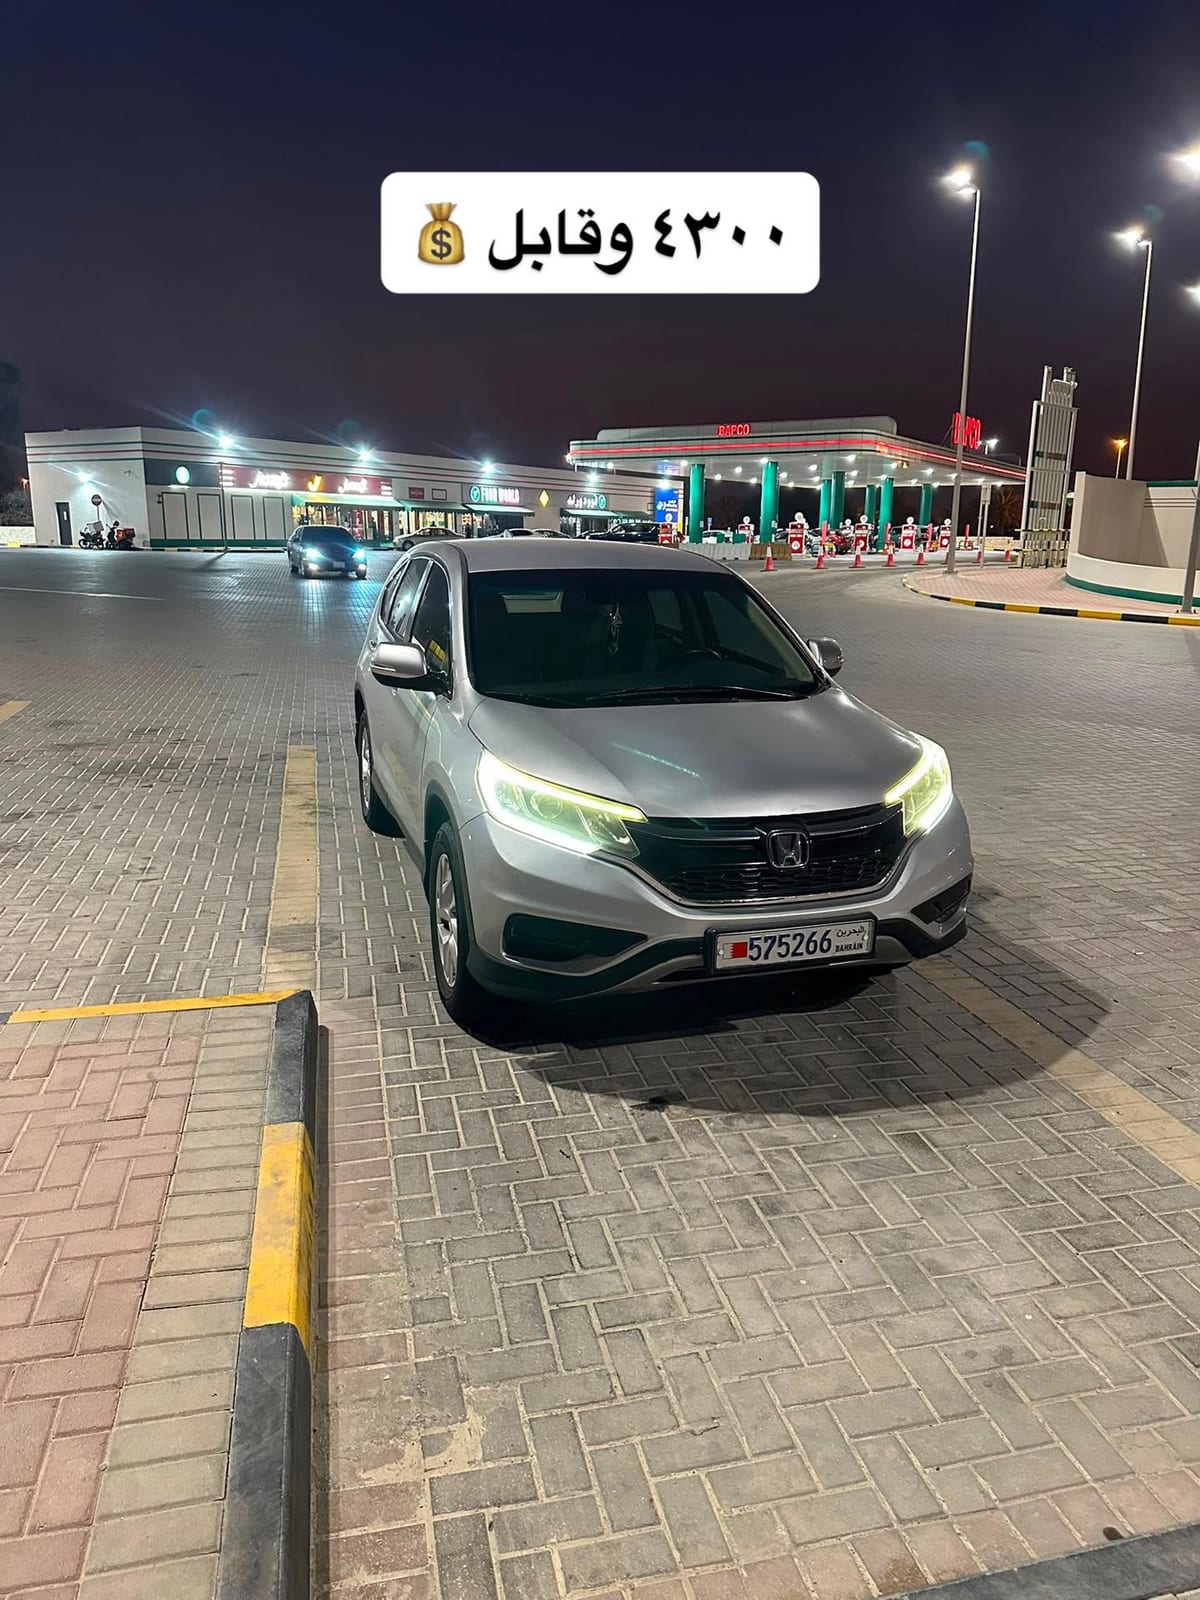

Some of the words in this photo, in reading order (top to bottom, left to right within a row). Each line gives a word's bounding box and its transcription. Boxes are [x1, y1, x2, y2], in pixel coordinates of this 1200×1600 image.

[718, 423, 750, 437] BAPCO
[953, 411, 981, 450] BPCO
[836, 926, 865, 938] البحرين
[749, 929, 832, 961] 575266
[835, 942, 864, 953] BAHRAIN
